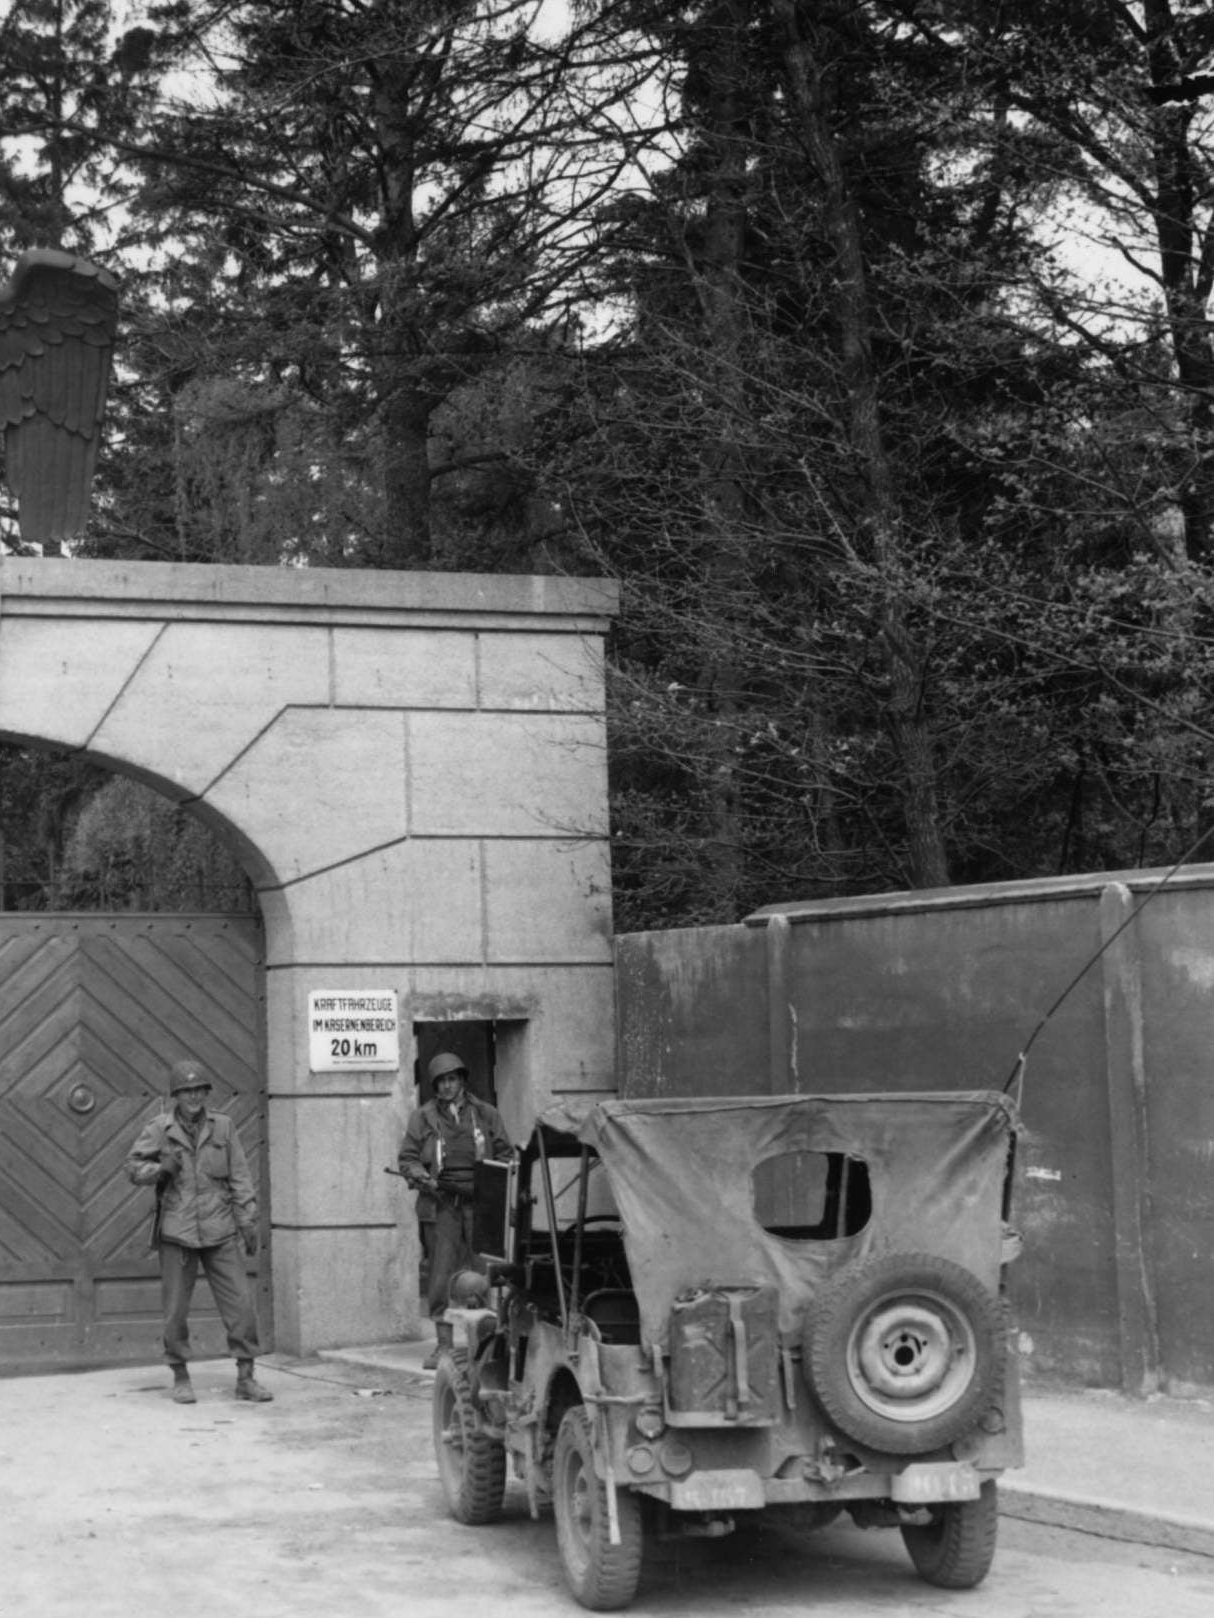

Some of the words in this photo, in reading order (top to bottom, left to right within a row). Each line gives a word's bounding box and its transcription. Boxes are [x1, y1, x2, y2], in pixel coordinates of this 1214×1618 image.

[314, 998, 393, 1011] KRAFTFAHRZEUGE
[313, 1019, 323, 1032] IM
[324, 1018, 396, 1032] KASERNENBEREICH
[331, 1038, 351, 1056] 20
[354, 1038, 377, 1056] km
